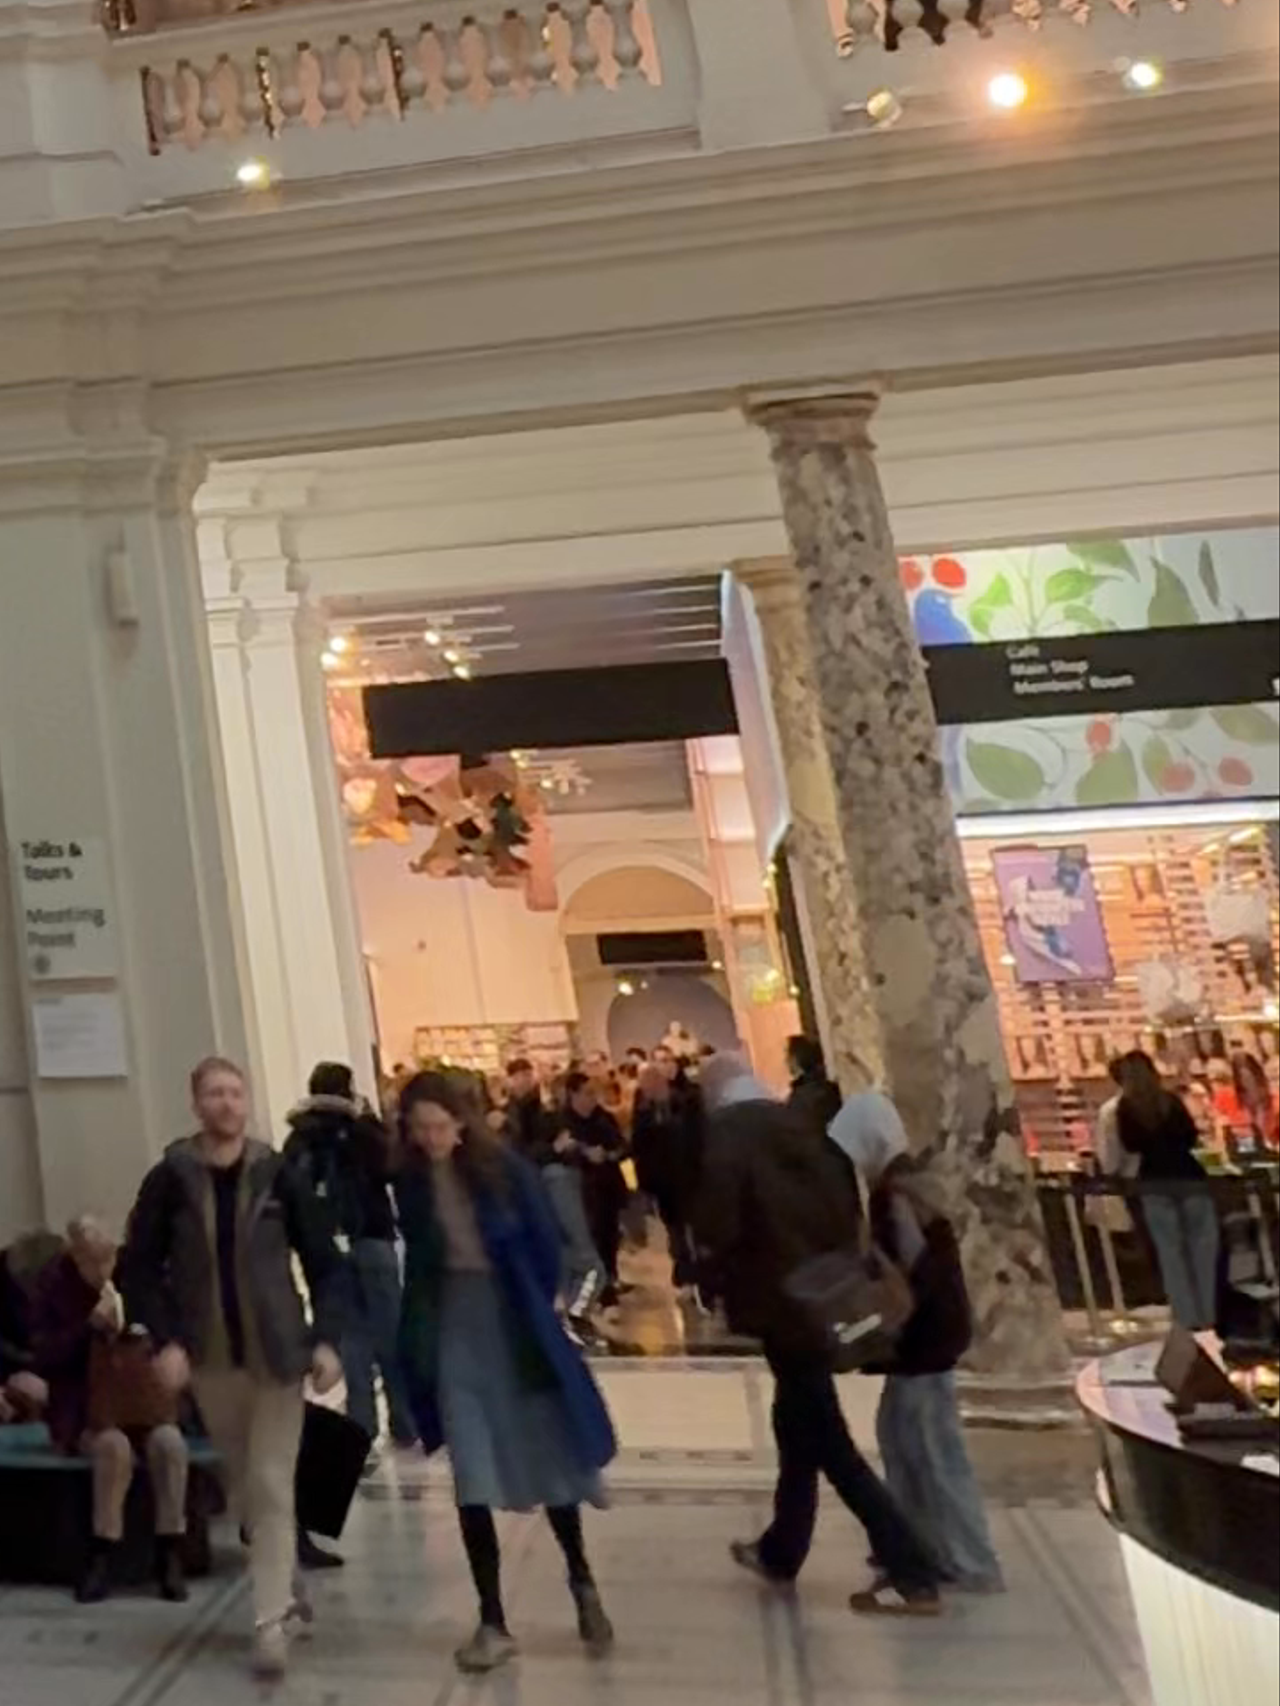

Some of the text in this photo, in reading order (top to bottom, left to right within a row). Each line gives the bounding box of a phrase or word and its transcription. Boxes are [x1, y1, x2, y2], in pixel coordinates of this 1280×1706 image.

[1009, 659, 1088, 676] Main Shop
[1089, 674, 1134, 690] Room
[21, 840, 82, 859] Talks &
[24, 865, 73, 880] Tours
[26, 908, 105, 927] Meeting
